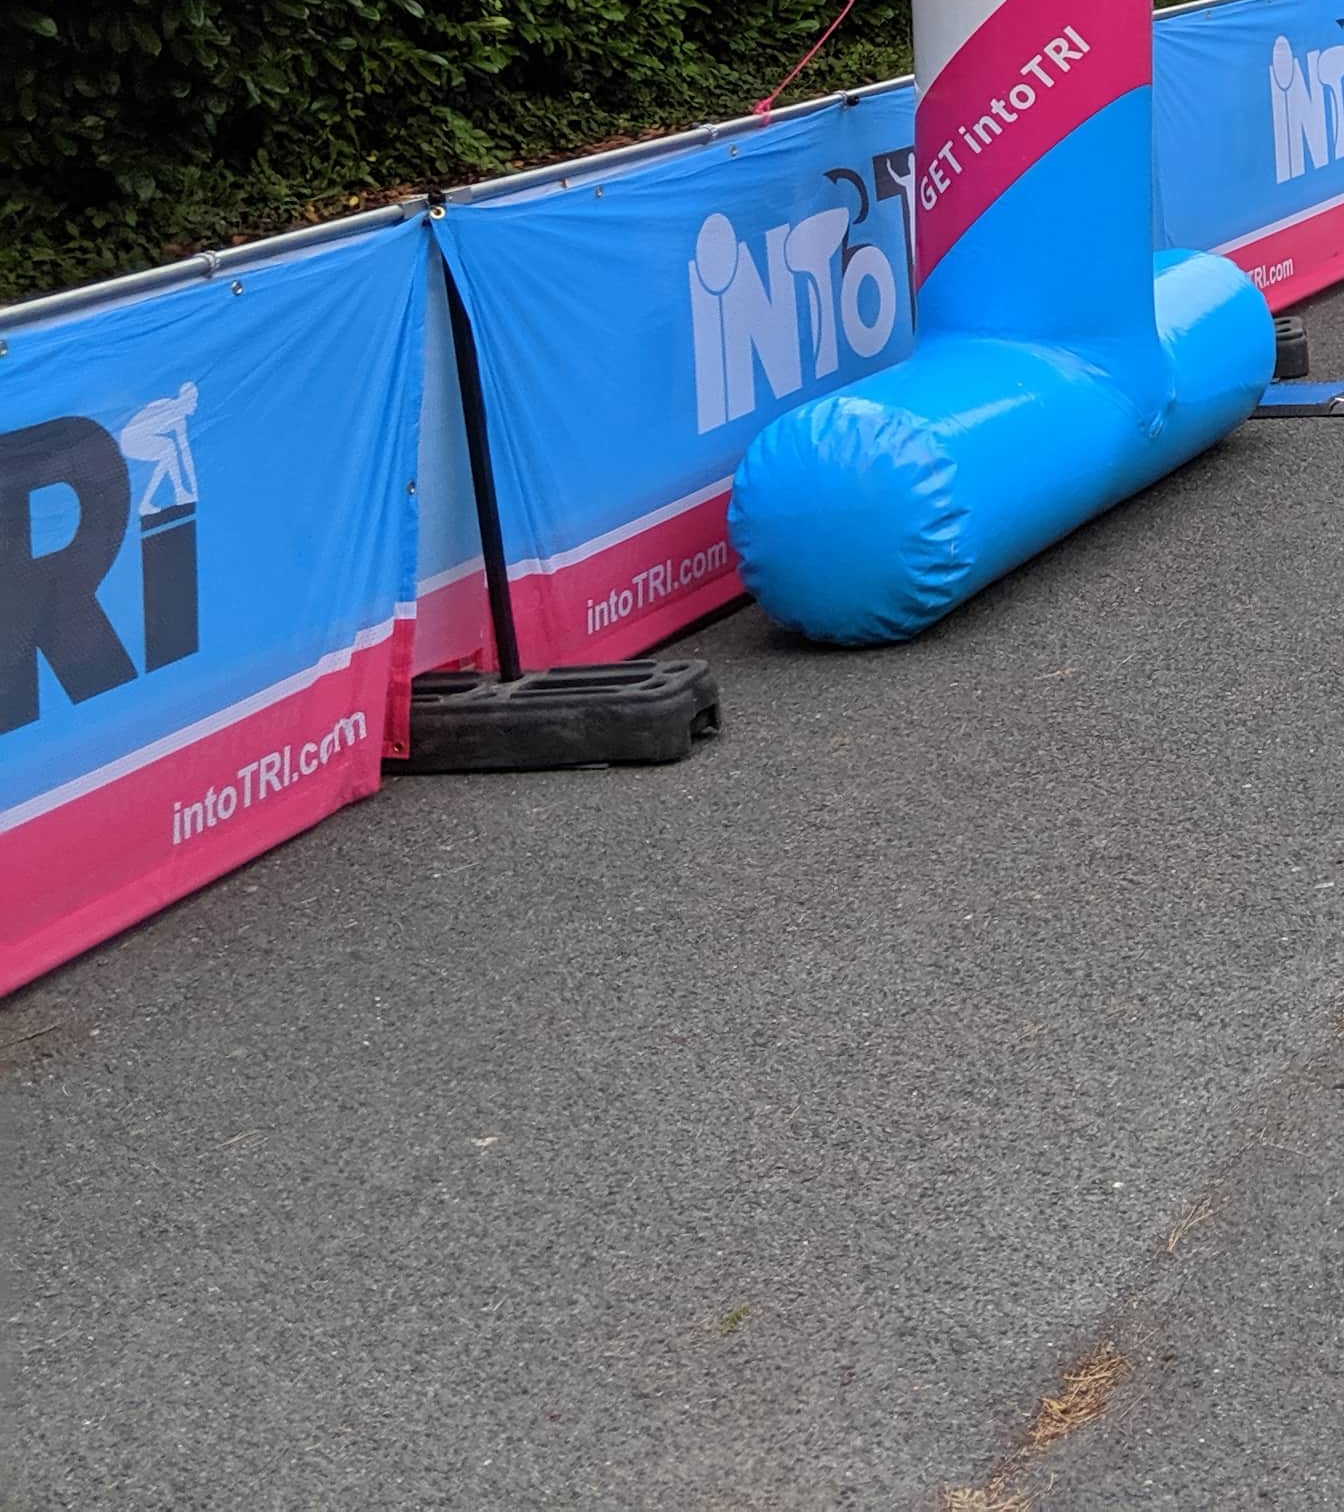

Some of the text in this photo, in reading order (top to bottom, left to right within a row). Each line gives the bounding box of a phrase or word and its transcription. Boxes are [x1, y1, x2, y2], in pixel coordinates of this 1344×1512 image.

[920, 25, 1091, 210] GET intoTRI
[586, 540, 728, 635] intoTRI.com
[173, 711, 367, 845] intoTRI.com
